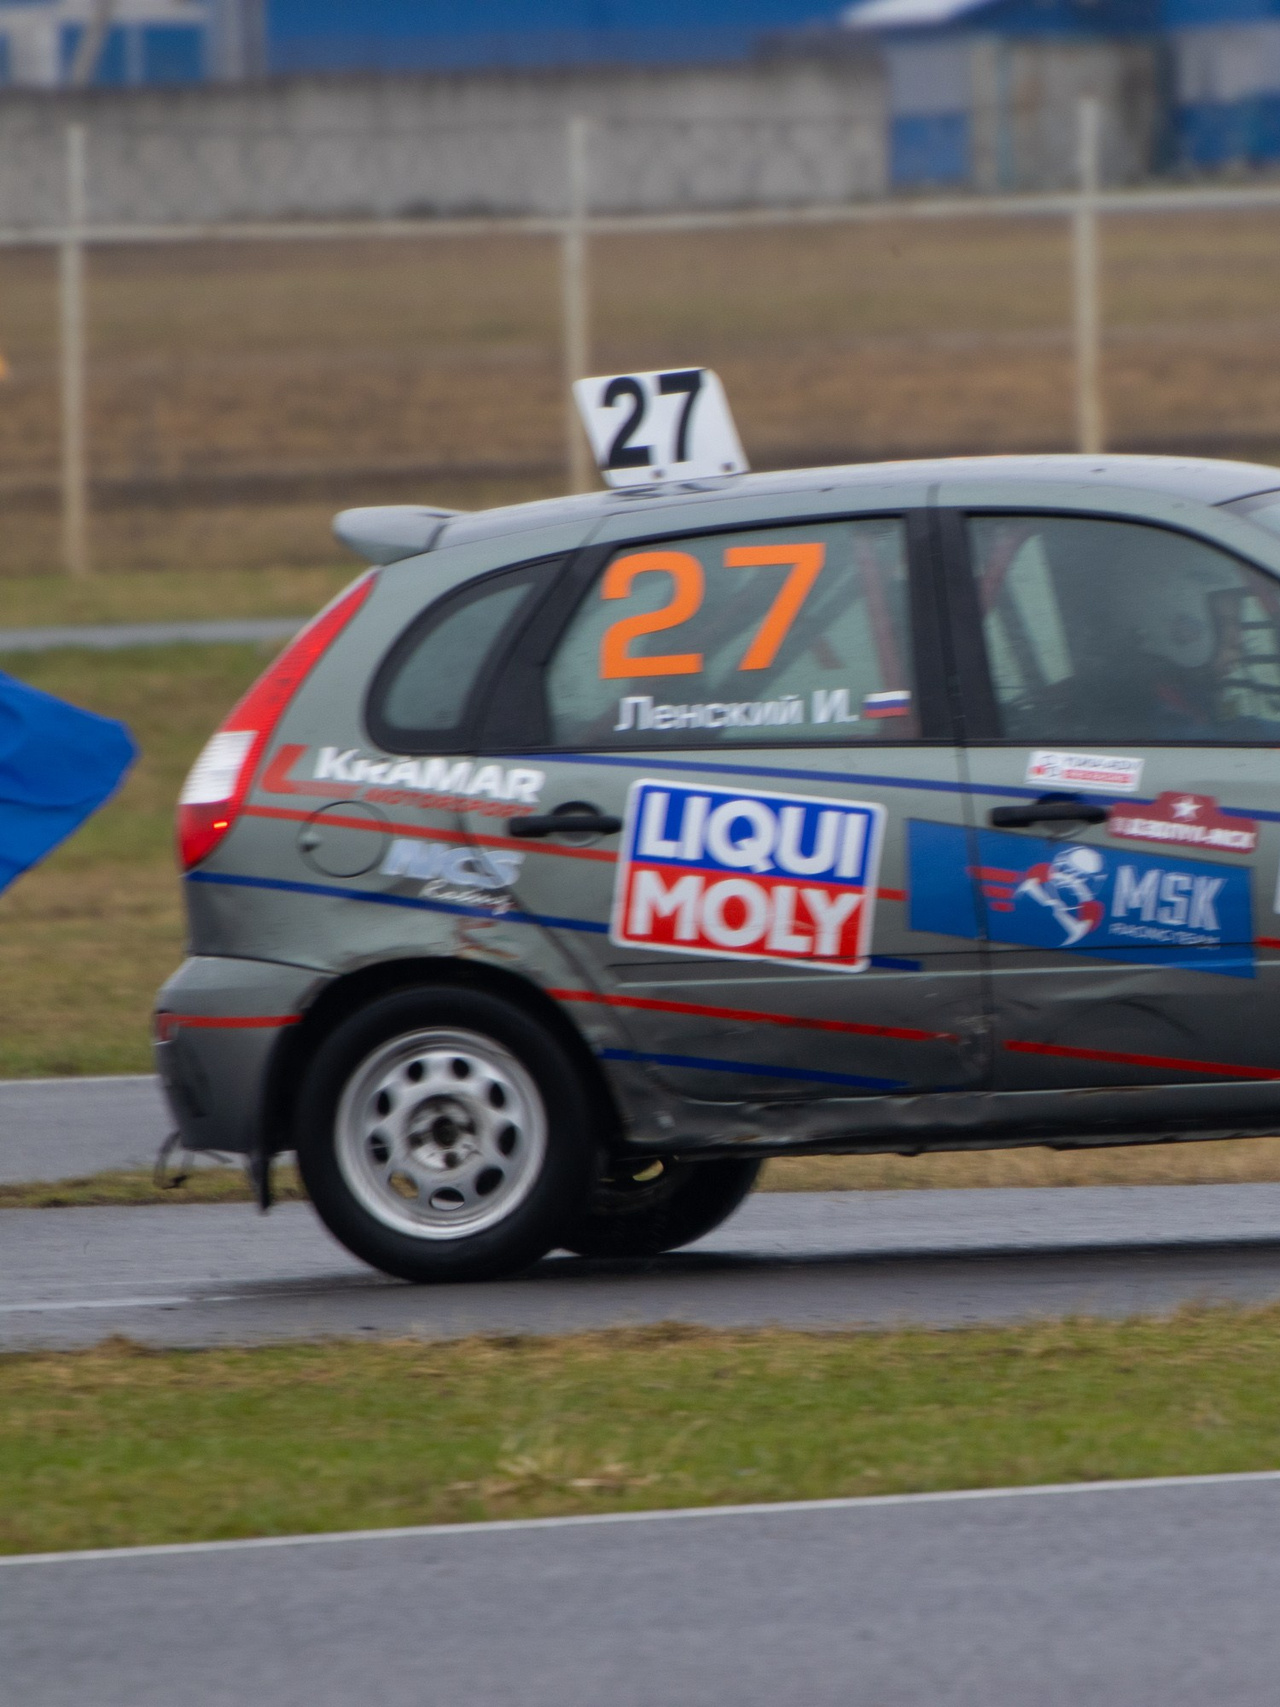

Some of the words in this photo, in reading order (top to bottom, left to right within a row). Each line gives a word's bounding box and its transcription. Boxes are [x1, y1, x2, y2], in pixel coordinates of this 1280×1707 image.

[596, 368, 705, 468] 27
[600, 541, 826, 680] 27
[613, 694, 805, 732] Ленский
[812, 689, 861, 724] И.
[636, 791, 869, 879] LIQUI
[625, 869, 867, 956] MOLY
[1110, 864, 1229, 931] MSK
